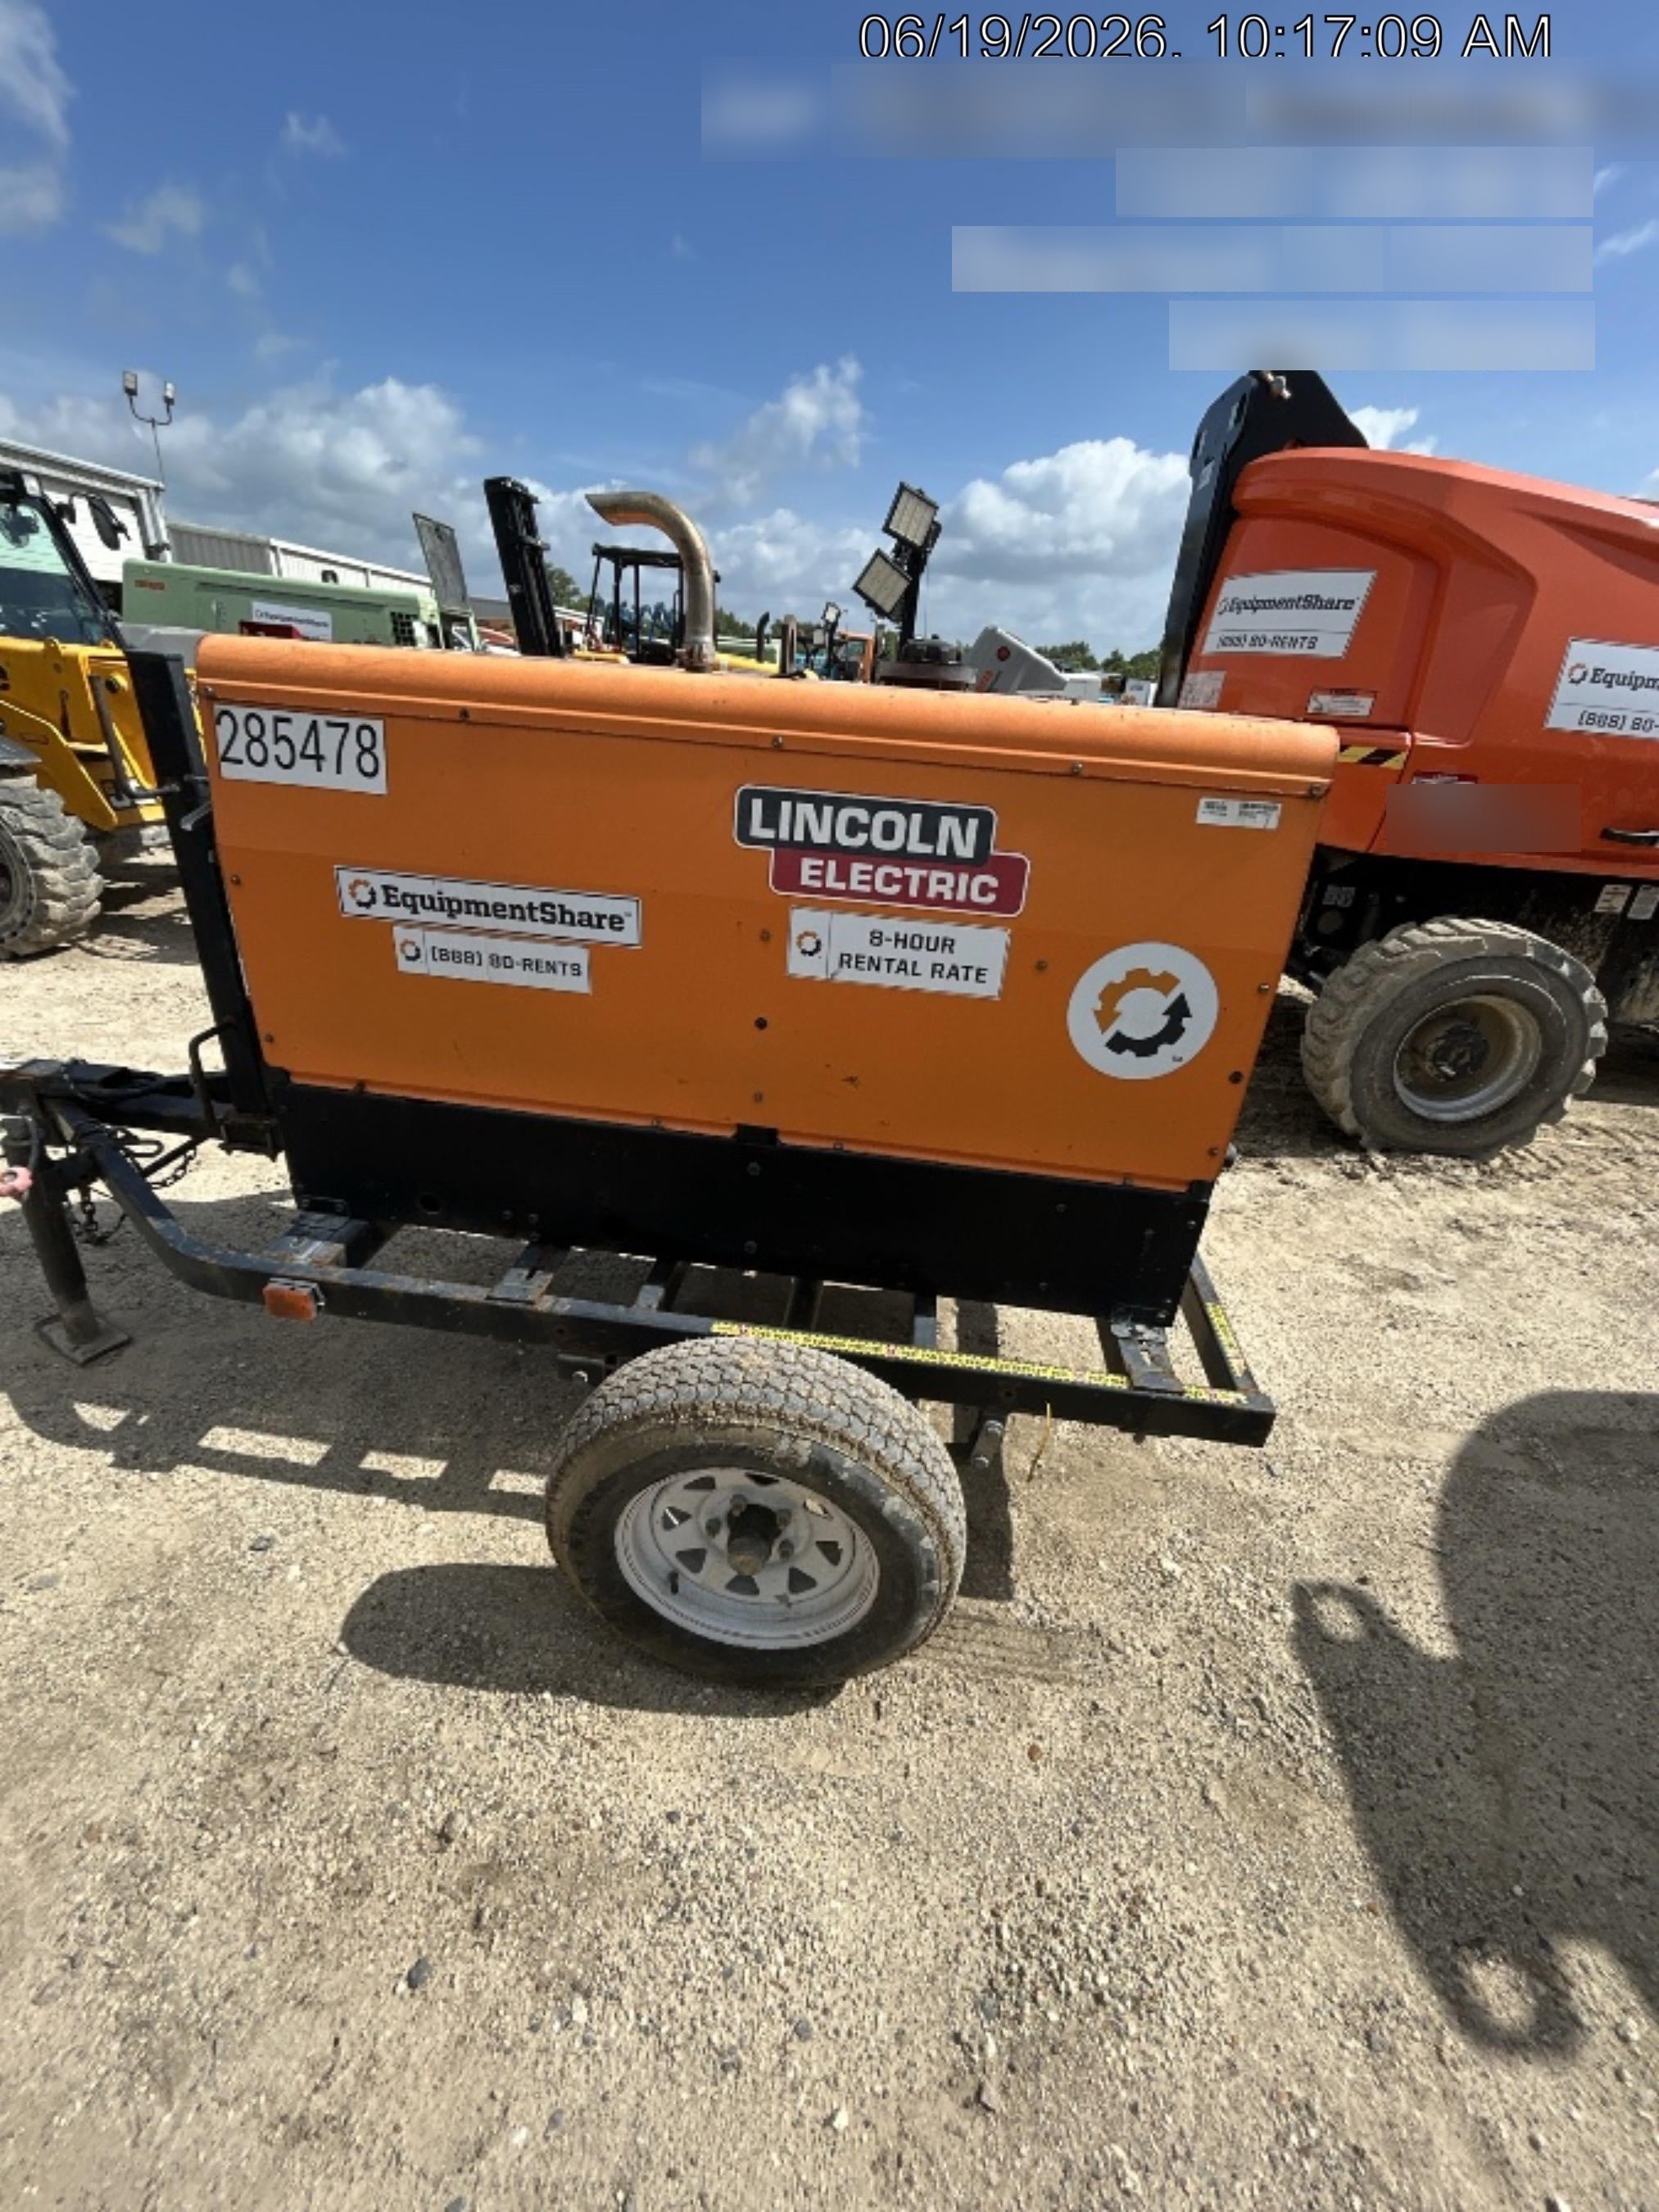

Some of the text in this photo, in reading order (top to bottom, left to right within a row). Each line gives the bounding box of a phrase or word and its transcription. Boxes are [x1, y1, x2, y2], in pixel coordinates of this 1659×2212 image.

[215, 709, 380, 778] 285478
[750, 797, 978, 859] LINCOLN
[800, 859, 999, 905] ELECTRIC
[380, 884, 625, 931] EquipmentShare
[868, 929, 955, 954] 8-HOUR
[488, 954, 582, 977] 80-RENTS
[839, 953, 988, 983] RENTAL RATE
